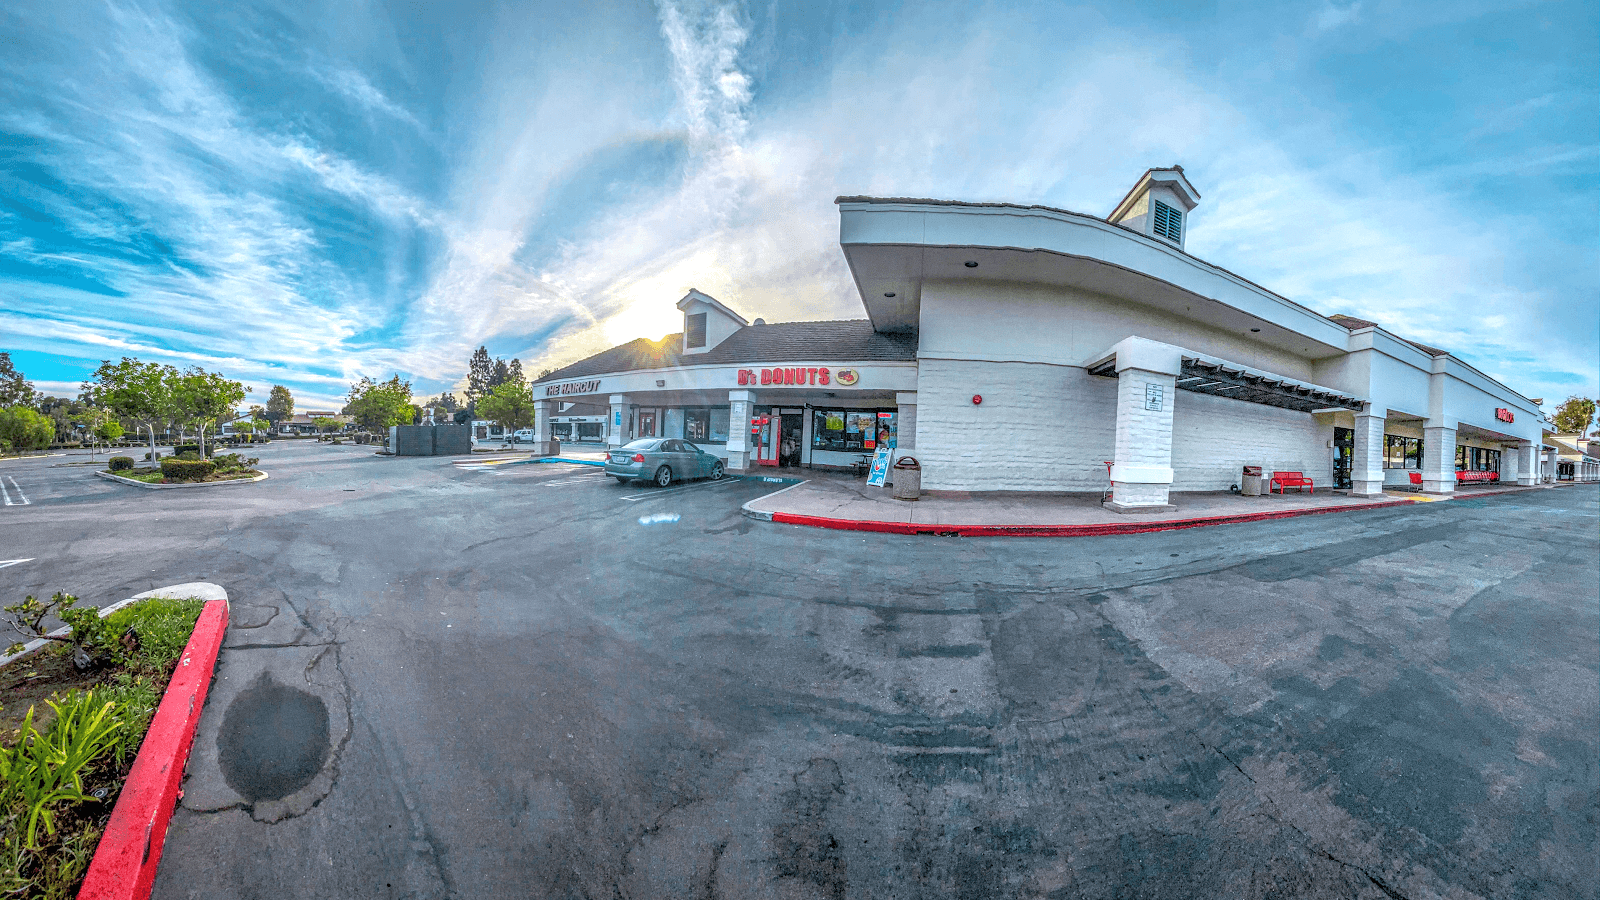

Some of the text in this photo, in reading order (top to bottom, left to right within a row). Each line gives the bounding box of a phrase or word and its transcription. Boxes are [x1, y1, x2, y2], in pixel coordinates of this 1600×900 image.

[761, 368, 830, 385] DONUTS
[545, 380, 601, 396] THE HAIRCUT
